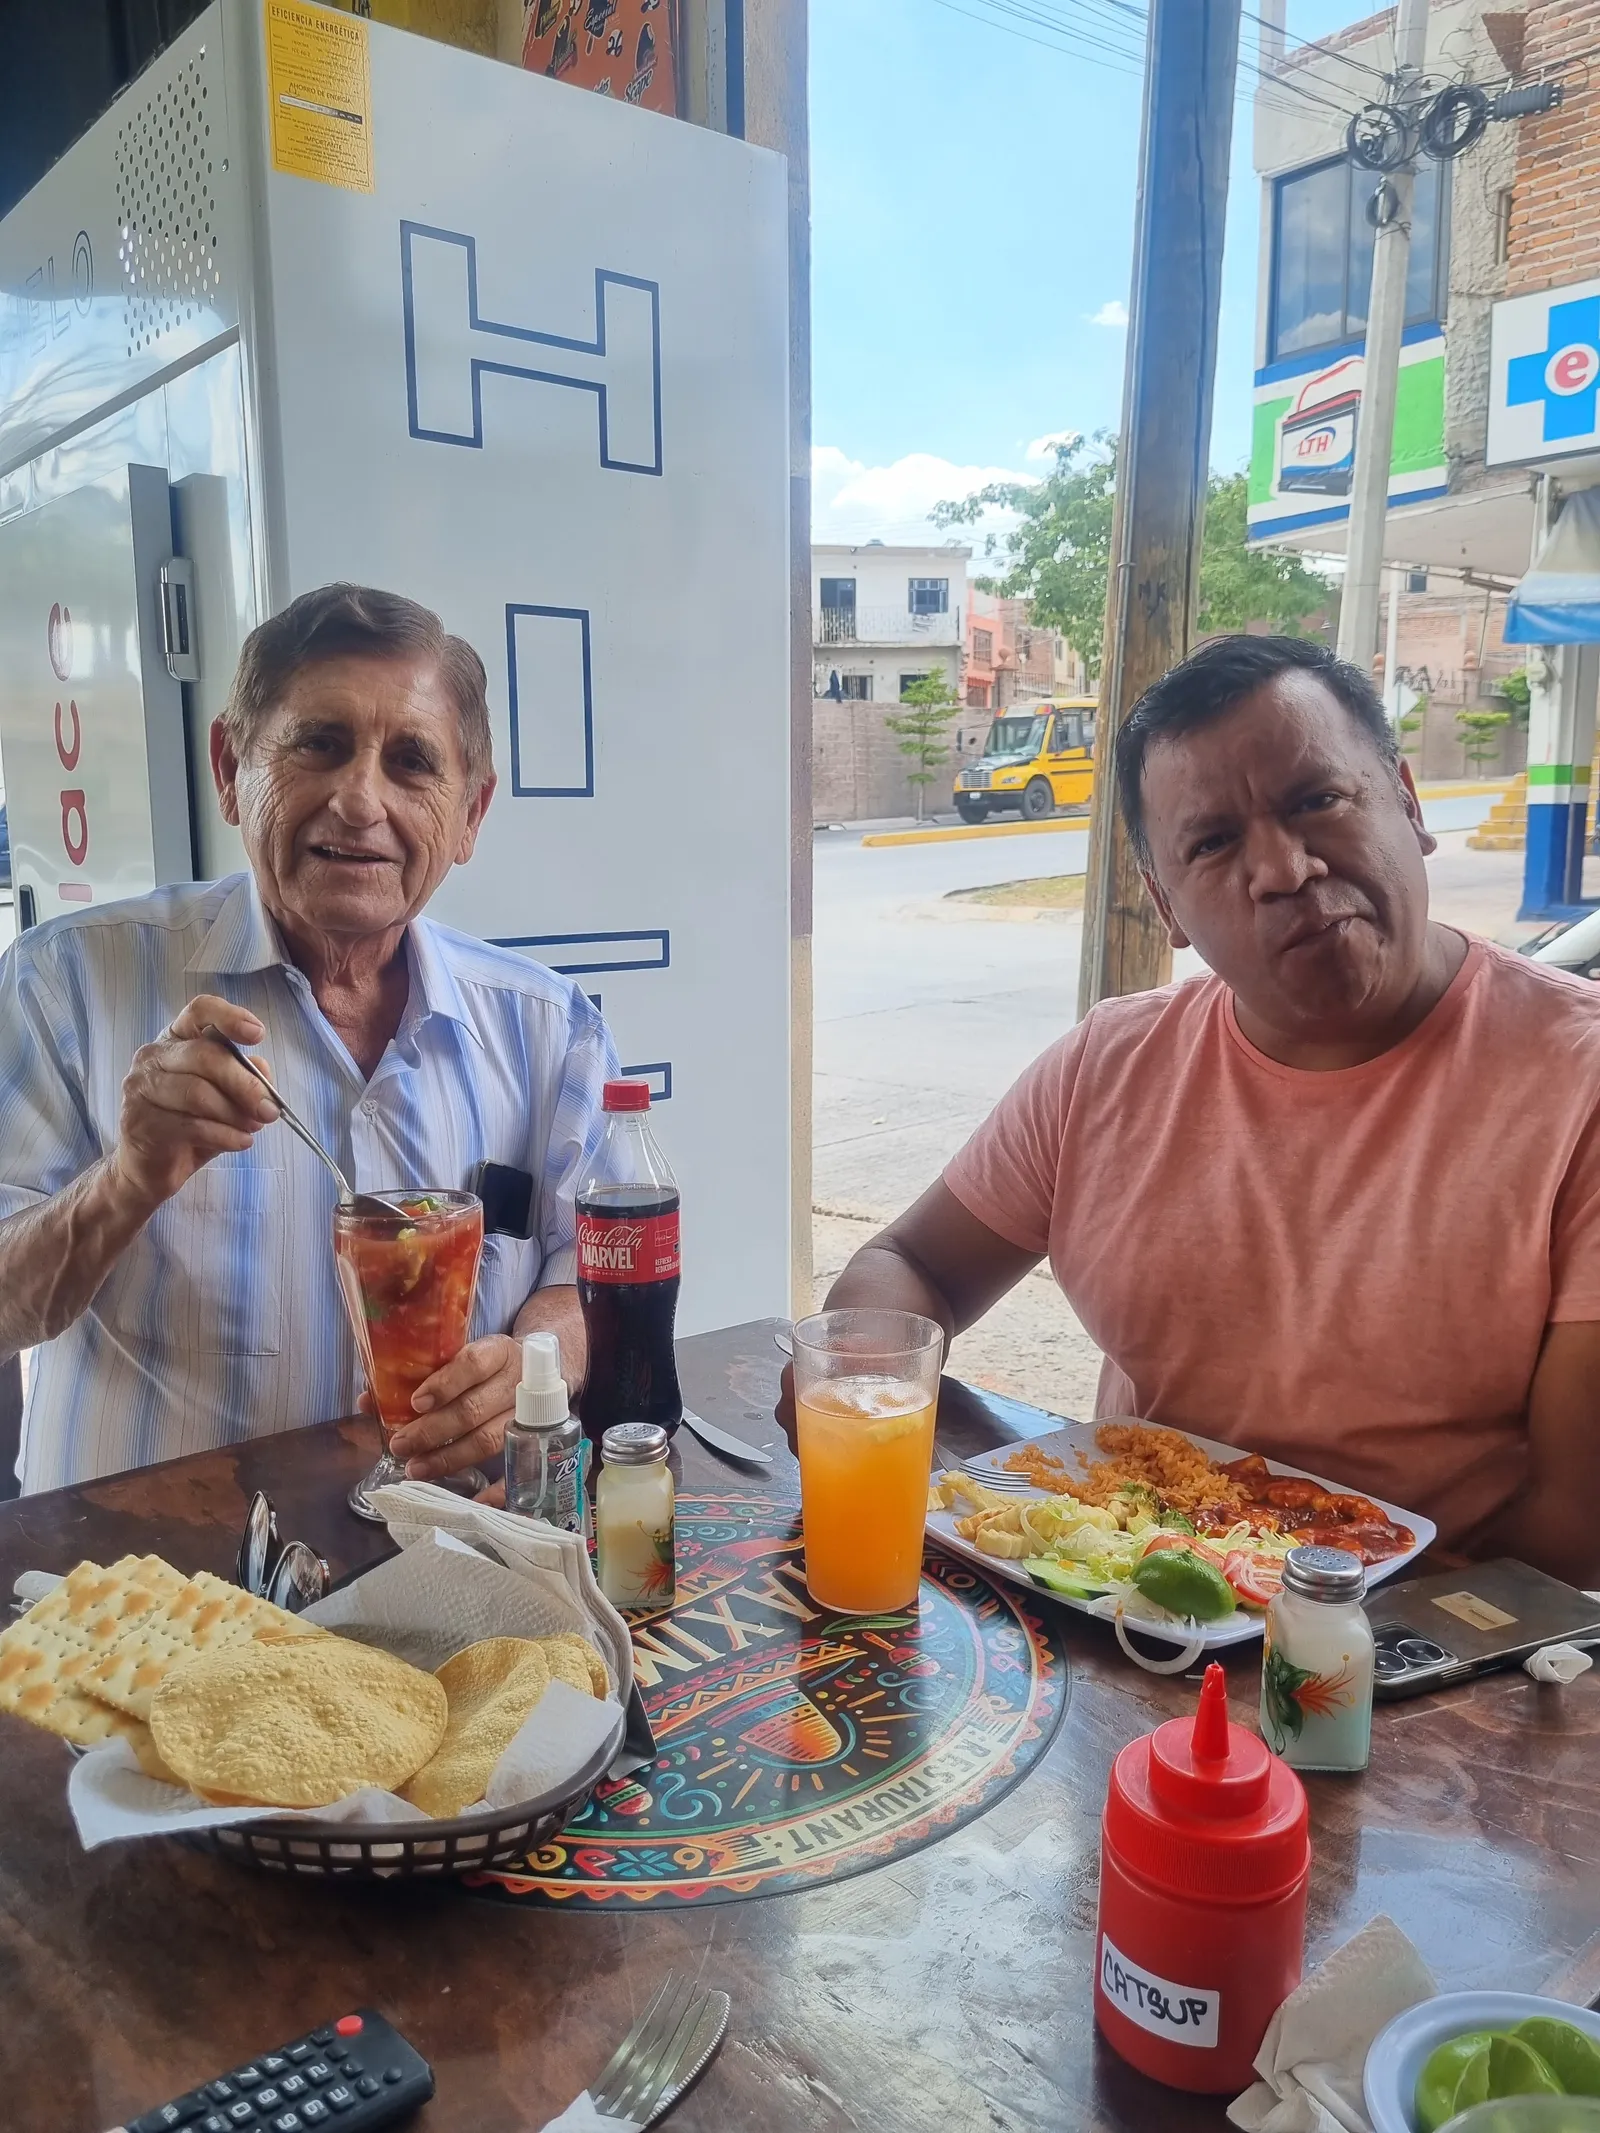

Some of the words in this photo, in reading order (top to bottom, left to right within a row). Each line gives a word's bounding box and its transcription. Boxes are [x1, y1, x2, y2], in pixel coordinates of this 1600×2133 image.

[271, 6, 313, 27] EFICIENCIA
[1297, 433, 1331, 458] LTH
[582, 1242, 635, 1270] MARVEL
[787, 1736, 993, 1855] RESTAURANT
[1103, 1948, 1208, 2026] CATSUP
[292, 2044, 307, 2054] 1
[265, 2057, 284, 2069] 4
[308, 2062, 328, 2078] 2
[238, 2066, 260, 2079] 7
[282, 2074, 304, 2091] 5
[257, 2088, 278, 2104] 8
[328, 2086, 349, 2102] 3
[230, 2101, 252, 2118] 0
[304, 2099, 326, 2116] 6
[276, 2113, 298, 2130] 9
